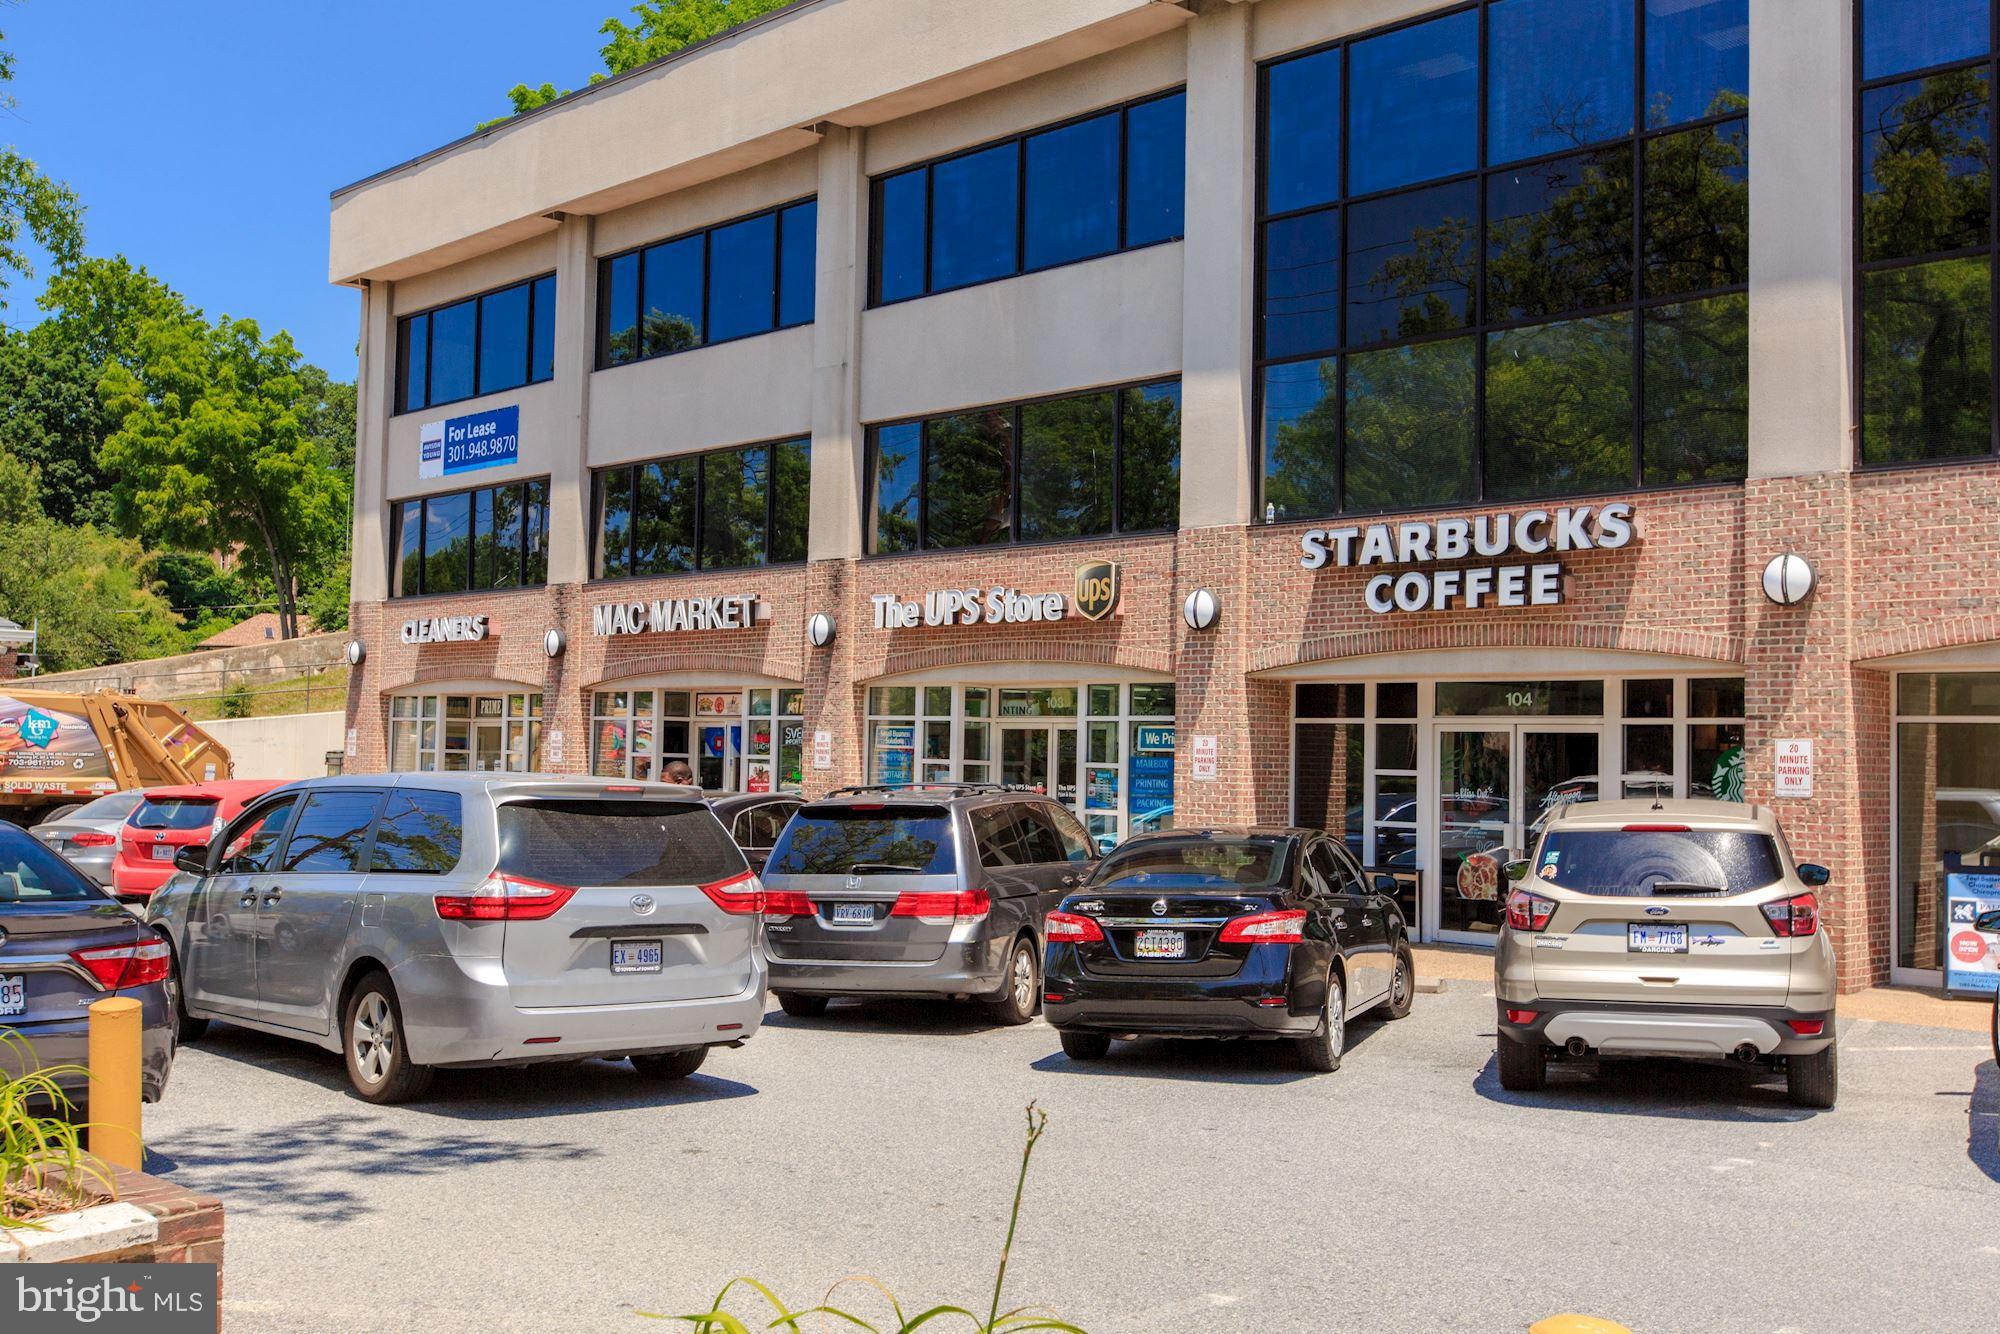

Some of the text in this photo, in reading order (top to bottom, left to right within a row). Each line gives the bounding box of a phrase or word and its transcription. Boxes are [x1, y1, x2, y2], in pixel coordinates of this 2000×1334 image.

[448, 421, 496, 442] For Lease
[448, 435, 516, 463] 301.948.9870
[1300, 502, 1634, 570] STARBUCKS
[1078, 577, 1111, 611] ups
[1364, 563, 1562, 614] COFFEE
[871, 586, 1065, 629] The UPS Store
[593, 593, 757, 637] MAC MARKET
[400, 615, 487, 645] CLEANERS
[1046, 696, 1064, 709] 103
[1505, 692, 1533, 706] 104
[1145, 731, 1160, 745] We
[1789, 744, 1799, 753] 20
[1135, 759, 1169, 769] MAILBOX
[1194, 756, 1215, 764] PARKING
[1779, 755, 1809, 764] MINUTE
[1198, 765, 1210, 773] ONLY
[1777, 766, 1810, 775] PARKING
[4, 781, 68, 791] SOLID WASTE
[1135, 778, 1169, 789] PRINTING
[1784, 776, 1803, 786] ONLY
[1476, 787, 1490, 799] Out
[1539, 790, 1583, 808] Afternoon
[1136, 799, 1168, 808] PACKING
[1657, 931, 1683, 945] 7768
[614, 949, 659, 964] EX 4965
[1, 984, 21, 1004] 85
